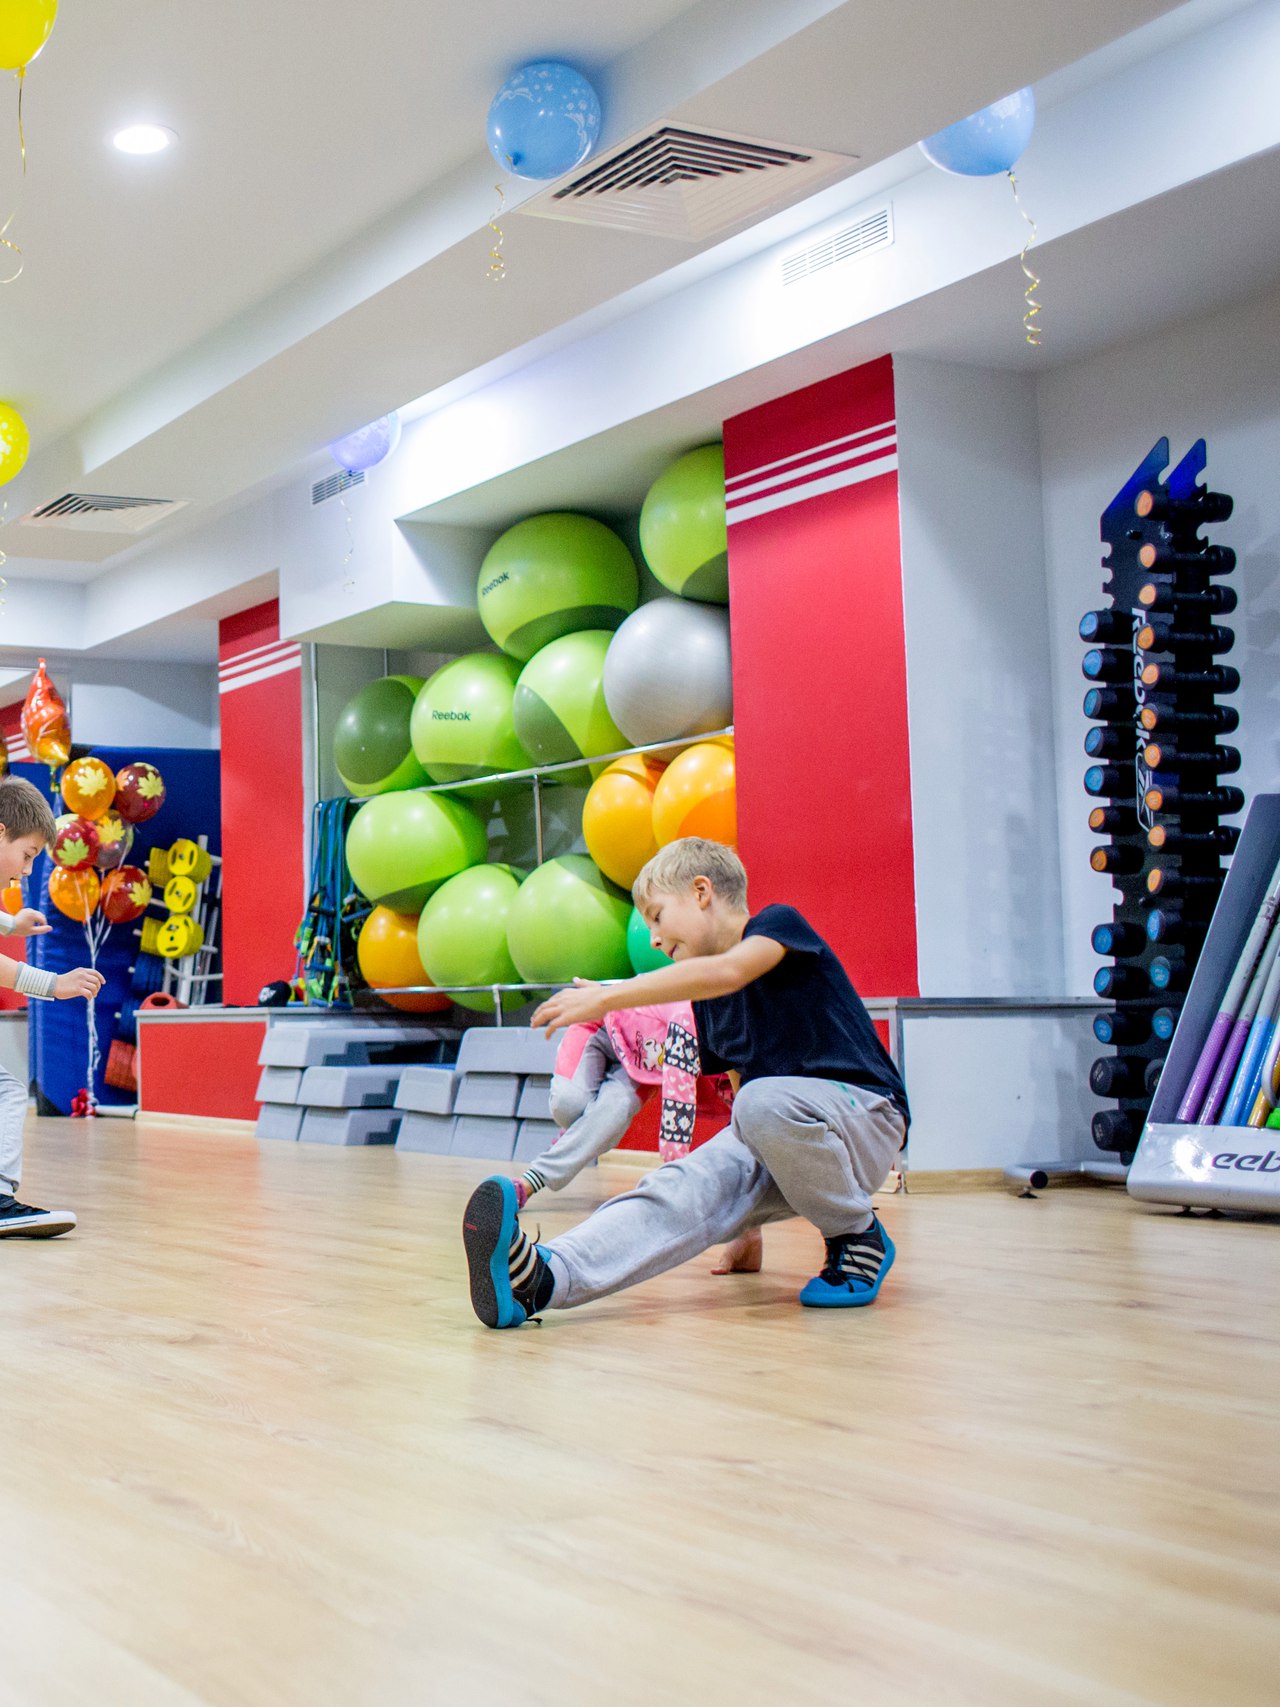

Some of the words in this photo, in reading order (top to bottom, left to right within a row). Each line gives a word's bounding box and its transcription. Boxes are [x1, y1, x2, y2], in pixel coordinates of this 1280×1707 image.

[482, 571, 510, 596] Reebok
[432, 709, 472, 721] Reebok
[1192, 1150, 1280, 1173] eeb
